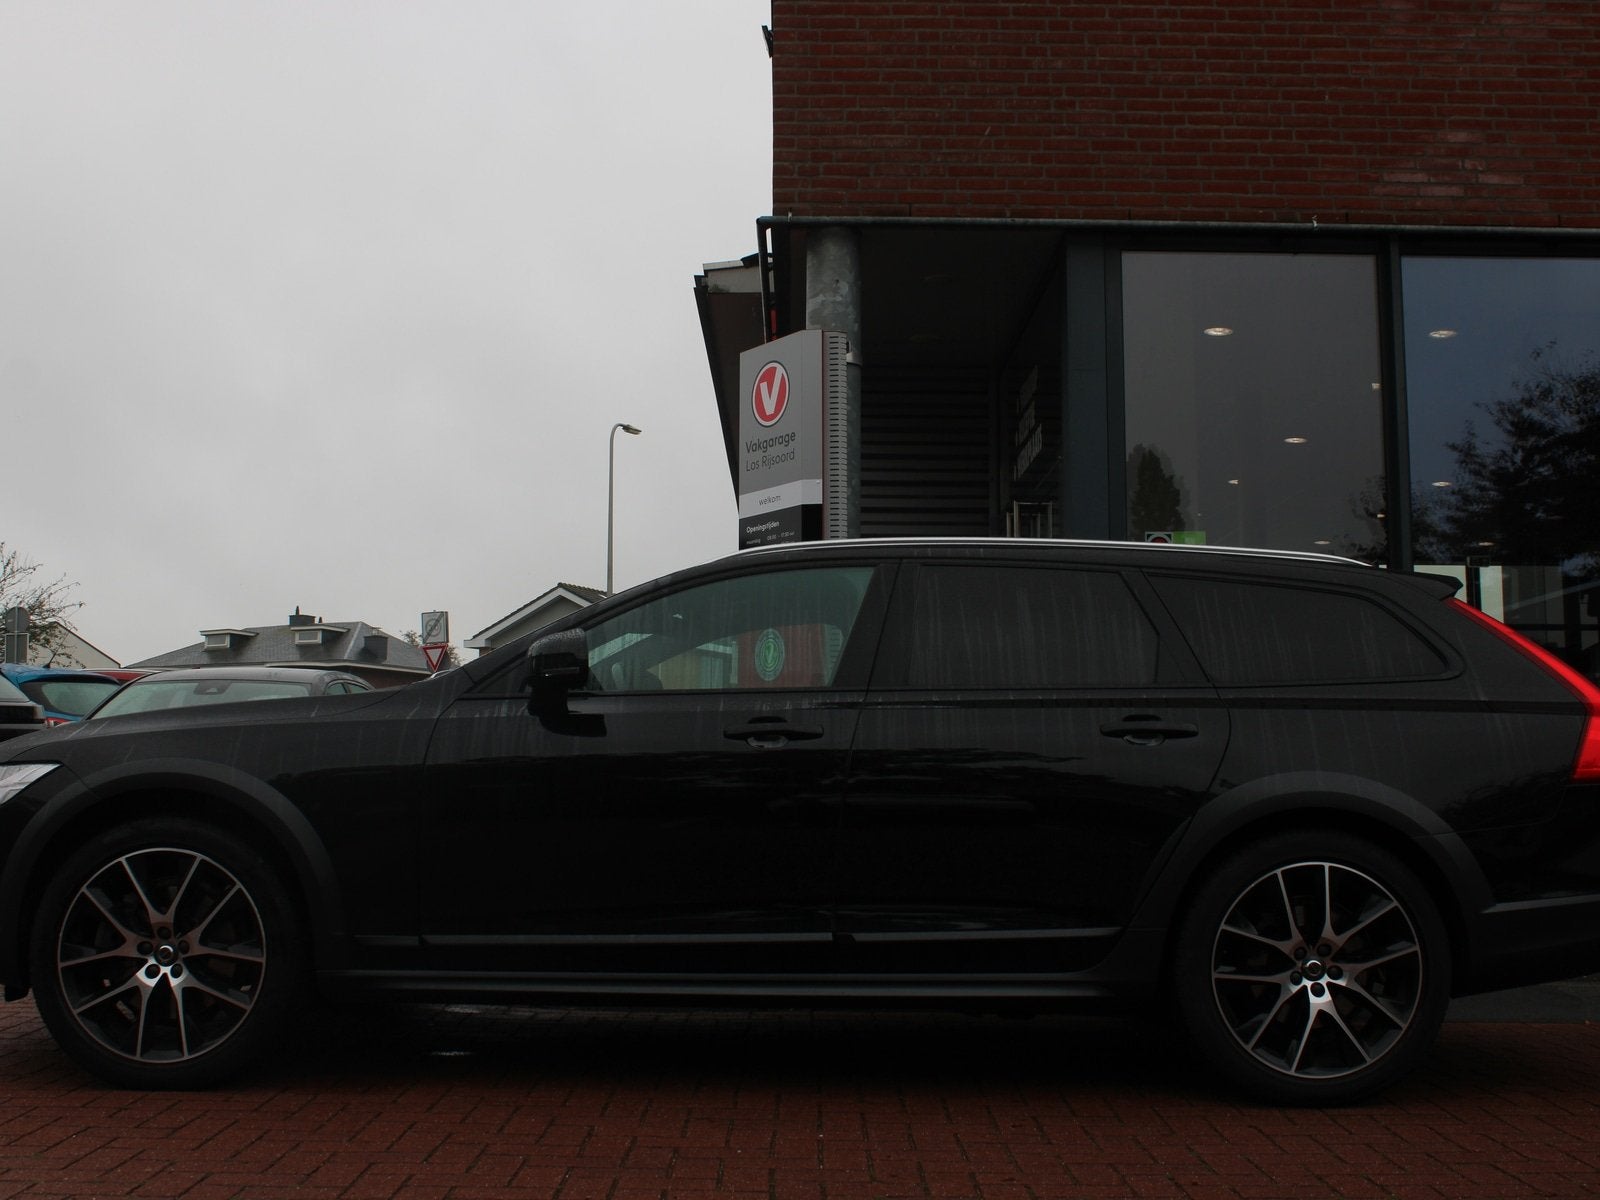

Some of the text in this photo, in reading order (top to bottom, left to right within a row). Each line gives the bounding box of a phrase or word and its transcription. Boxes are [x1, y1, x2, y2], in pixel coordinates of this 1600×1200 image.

[745, 431, 796, 454] Vakgarage
[762, 448, 795, 470] Rijsoord
[759, 495, 781, 506] welkom
